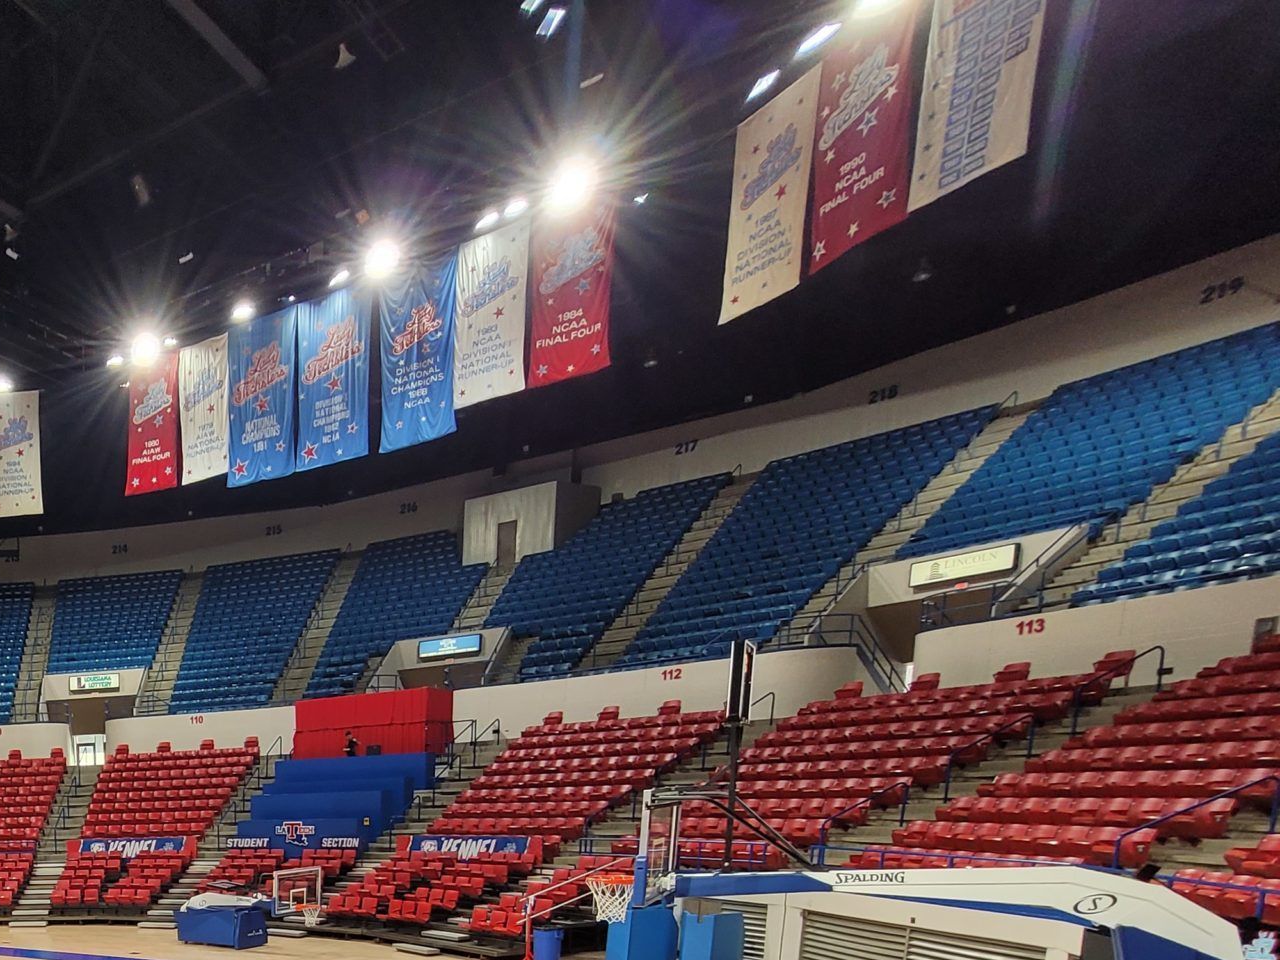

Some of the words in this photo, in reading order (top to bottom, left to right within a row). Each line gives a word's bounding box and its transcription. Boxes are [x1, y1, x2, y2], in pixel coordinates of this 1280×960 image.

[839, 152, 866, 176] 1990
[835, 166, 866, 192] NCAA
[820, 191, 849, 216] FINAL
[853, 167, 885, 194] FOUR
[749, 220, 781, 243] NCAA
[737, 231, 785, 261] DIVISION
[735, 239, 792, 273] NATIONAL
[558, 308, 583, 321] 1984
[536, 332, 569, 348] FINAL
[570, 323, 602, 341] FOUR
[552, 318, 588, 335] NCAA
[472, 333, 501, 348] NCAA
[461, 352, 513, 370] NATIONAL
[462, 342, 507, 362] DIVISION
[395, 366, 441, 384] NATIONAL
[396, 357, 434, 376] DIVISION
[458, 359, 515, 380] RUNNER-UP
[391, 373, 445, 395] CHAMPIONS
[404, 397, 430, 409] NCAA
[868, 386, 898, 404] 218
[245, 414, 278, 432] NATIONAL
[188, 437, 224, 450] NATIONAL
[196, 430, 215, 441] AIAW
[242, 425, 280, 445] CHAMPIONS
[142, 447, 161, 456] AIAW
[675, 440, 697, 455] 217
[132, 456, 152, 465] FINAL
[152, 452, 171, 462] FOUR
[400, 502, 418, 515] 216
[266, 525, 282, 536] 215
[111, 544, 128, 555] 214
[944, 551, 997, 569] LINCOLN
[1016, 619, 1045, 636] 113
[661, 668, 682, 681] 112
[190, 715, 204, 725] 110
[283, 821, 315, 839] TECH
[227, 838, 269, 848] STUDENT
[322, 838, 360, 848] SECTION
[835, 871, 905, 884] SPALDING
